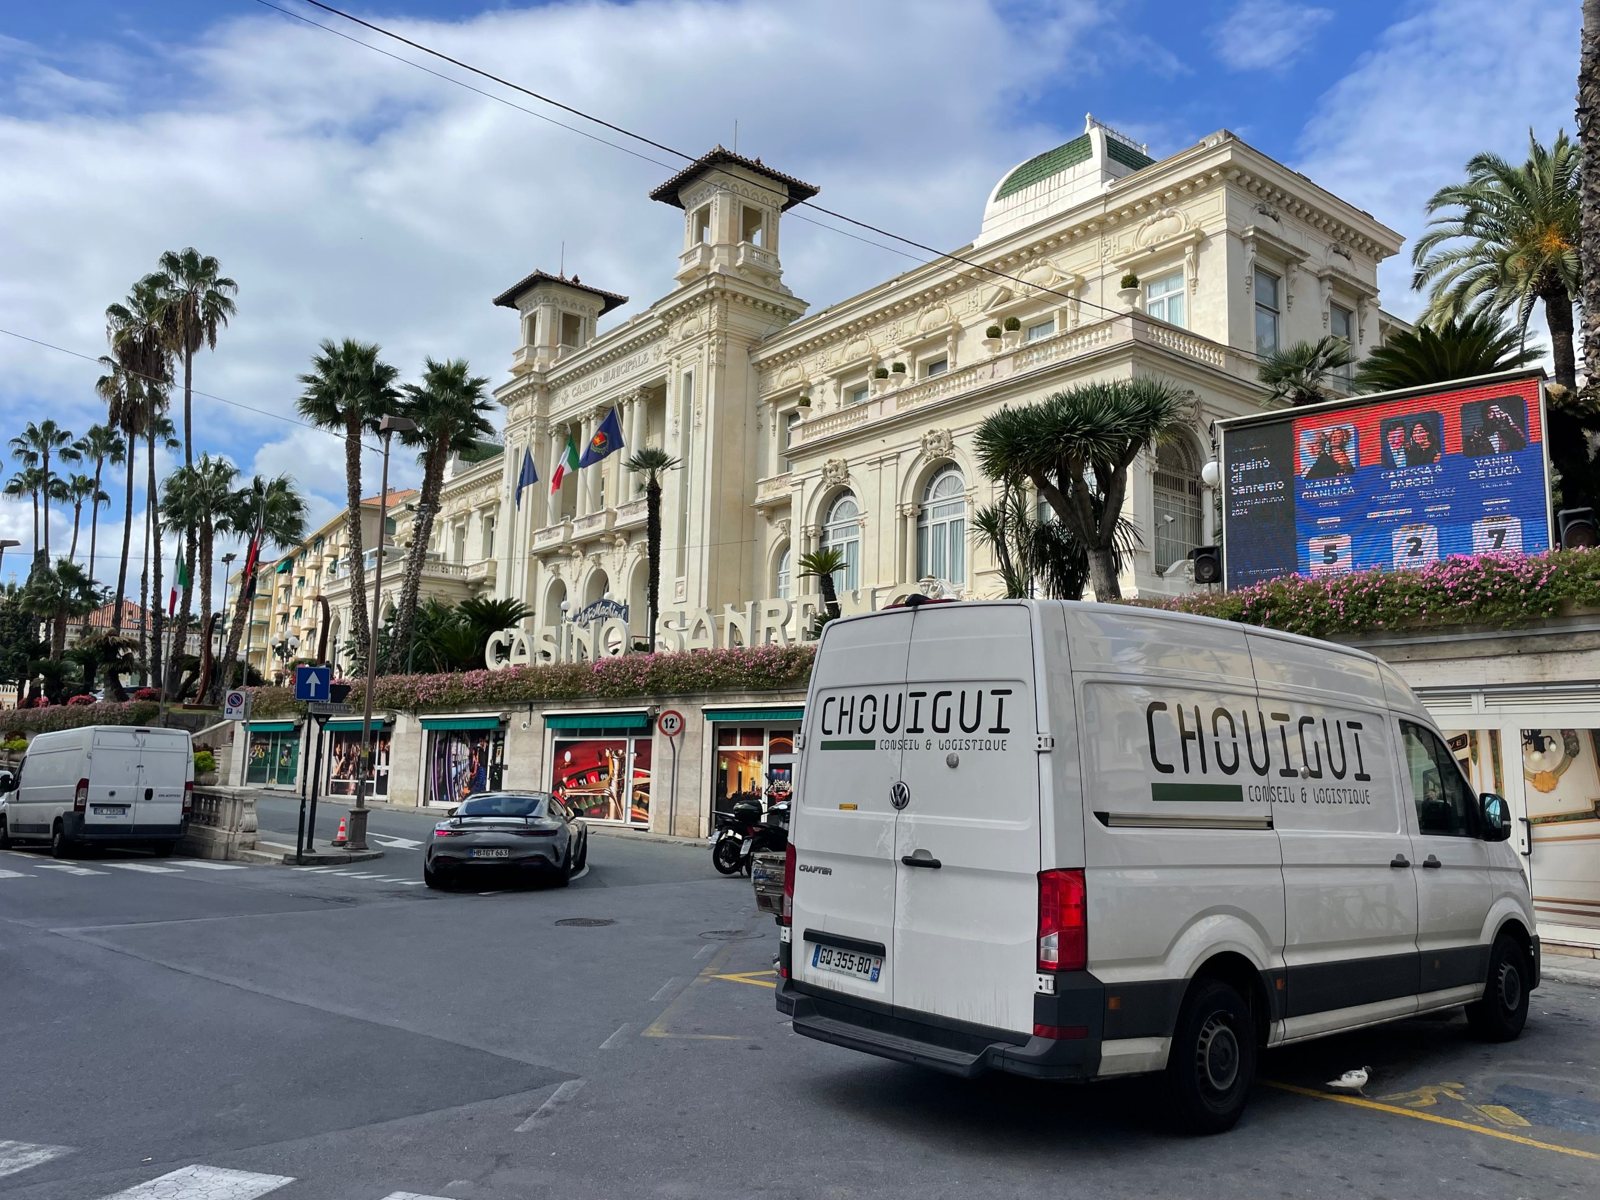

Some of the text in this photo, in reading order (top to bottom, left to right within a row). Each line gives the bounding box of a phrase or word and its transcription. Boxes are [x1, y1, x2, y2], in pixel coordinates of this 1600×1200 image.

[1230, 481, 1285, 495] Sanremo
[1406, 537, 1424, 556] 2
[1487, 528, 1507, 549] 7
[1323, 543, 1338, 564] 5
[485, 618, 631, 671] CASINO
[820, 689, 1013, 736] CHOUIGUI
[879, 739, 1008, 751] CONSEIL & LOGISTIQUE
[1146, 701, 1371, 782] CHOUIGUI
[1248, 785, 1371, 805] CONSEIL & LOGISTIQUE
[798, 864, 832, 876] CRAFTER
